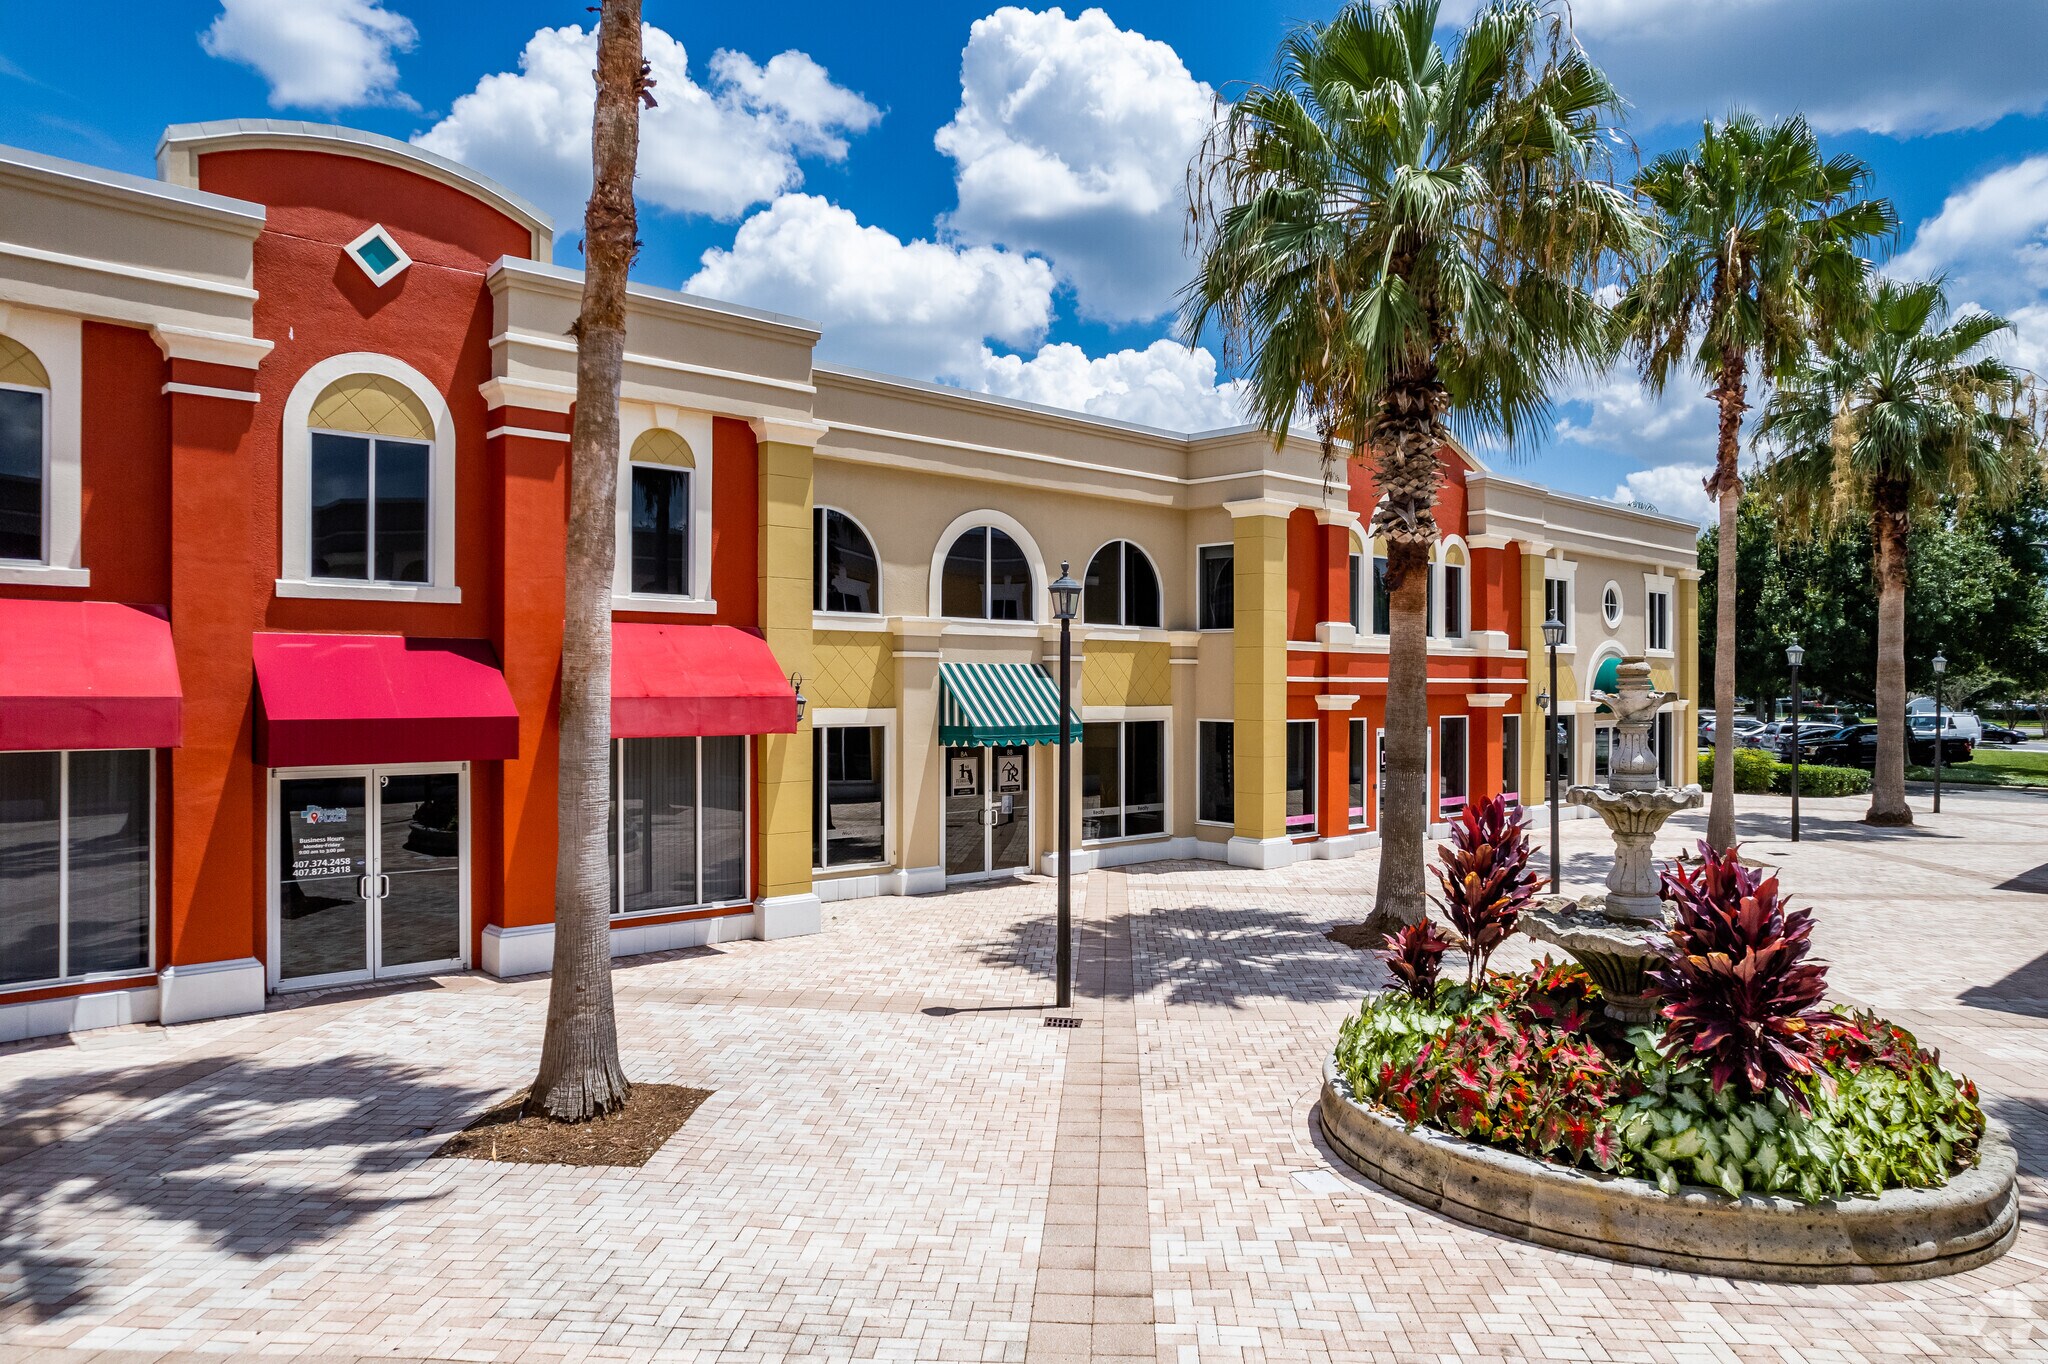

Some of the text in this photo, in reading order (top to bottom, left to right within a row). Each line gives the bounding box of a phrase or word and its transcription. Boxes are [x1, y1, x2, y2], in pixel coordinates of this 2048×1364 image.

[381, 776, 388, 787] 9
[292, 858, 350, 868] 407.374.2458
[292, 866, 350, 876] 407.873.3418
